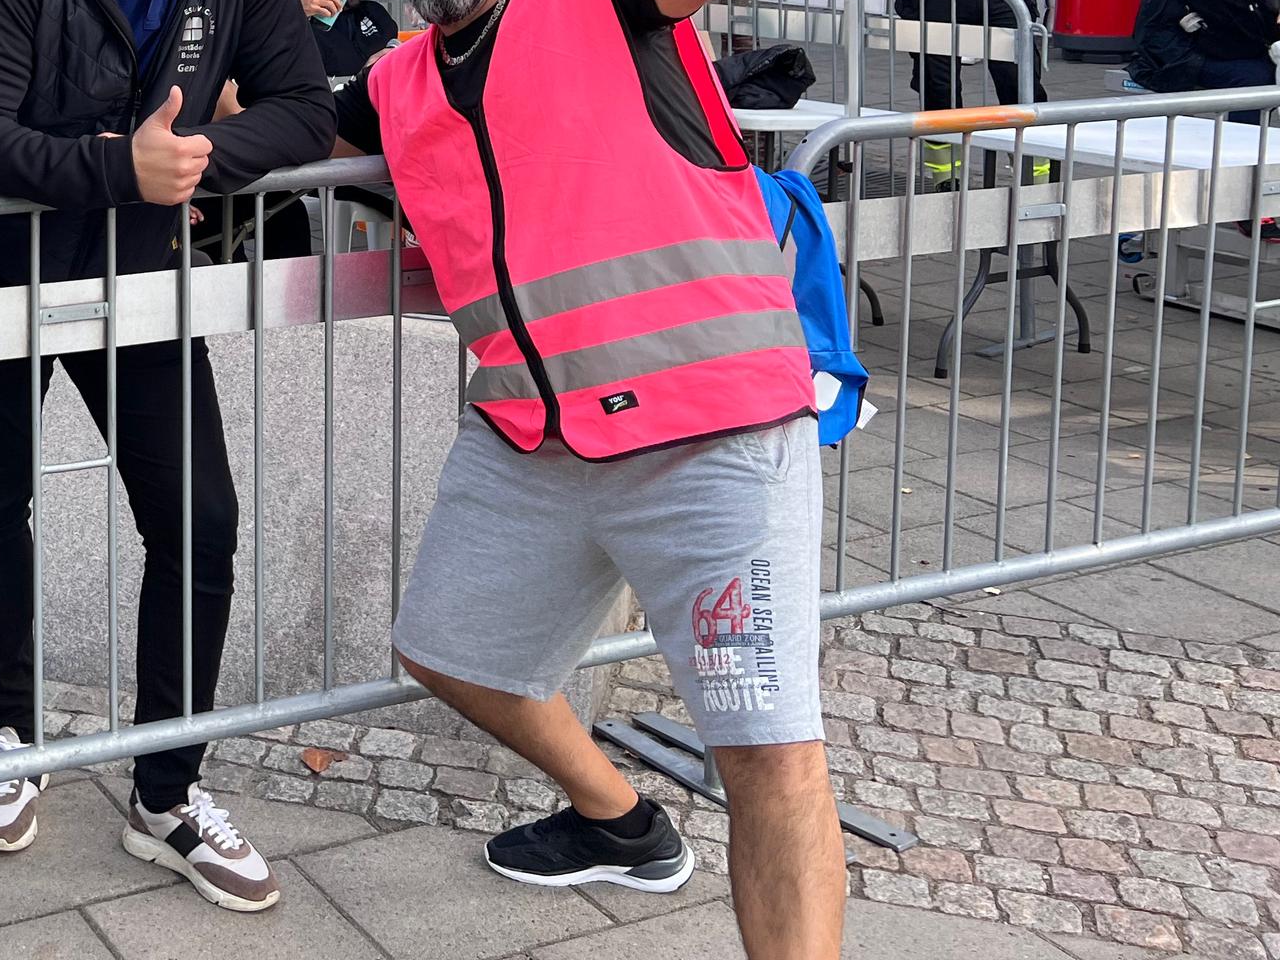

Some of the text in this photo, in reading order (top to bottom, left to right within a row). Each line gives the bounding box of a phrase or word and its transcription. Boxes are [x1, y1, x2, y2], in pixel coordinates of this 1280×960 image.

[750, 559, 771, 602] OCEAN
[752, 607, 773, 631] SEA
[702, 676, 775, 712] ROUTE
